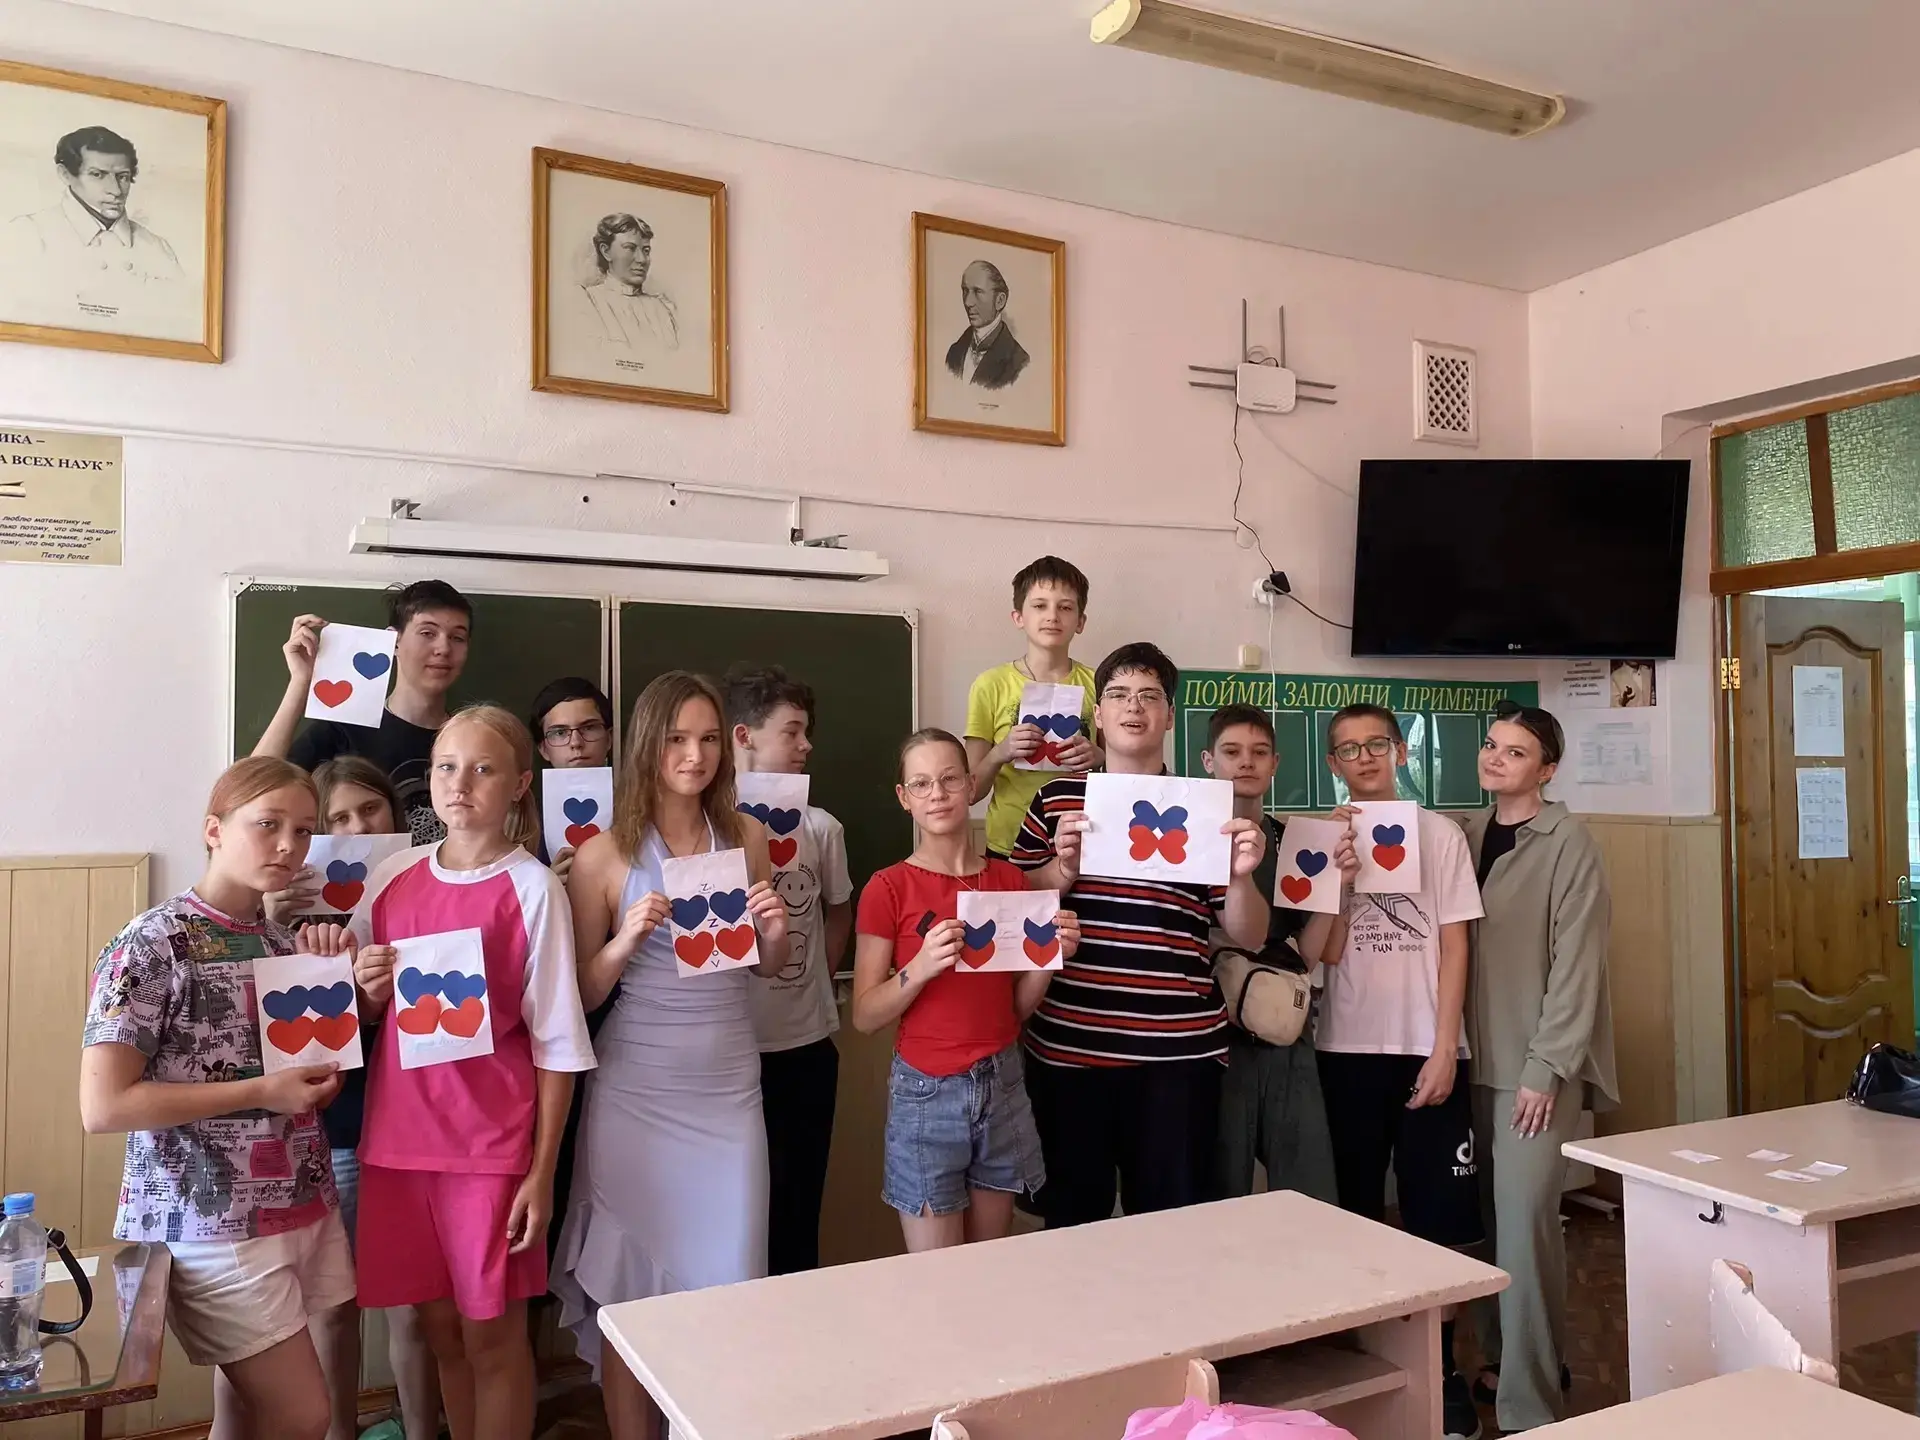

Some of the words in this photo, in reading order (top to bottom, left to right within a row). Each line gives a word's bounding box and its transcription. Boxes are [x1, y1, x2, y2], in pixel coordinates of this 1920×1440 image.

[12, 455, 54, 467] ВСЕХ
[58, 458, 102, 470] НАУК
[41, 551, 65, 559] Петер
[1183, 674, 1279, 710] ПОЙМИ,
[1283, 681, 1396, 712] ЗАПОМНИ,
[1402, 686, 1508, 711] ПРИМЕНИ!
[1365, 932, 1383, 942] AND
[1383, 931, 1403, 942] HAVE
[1372, 943, 1393, 954] FUN
